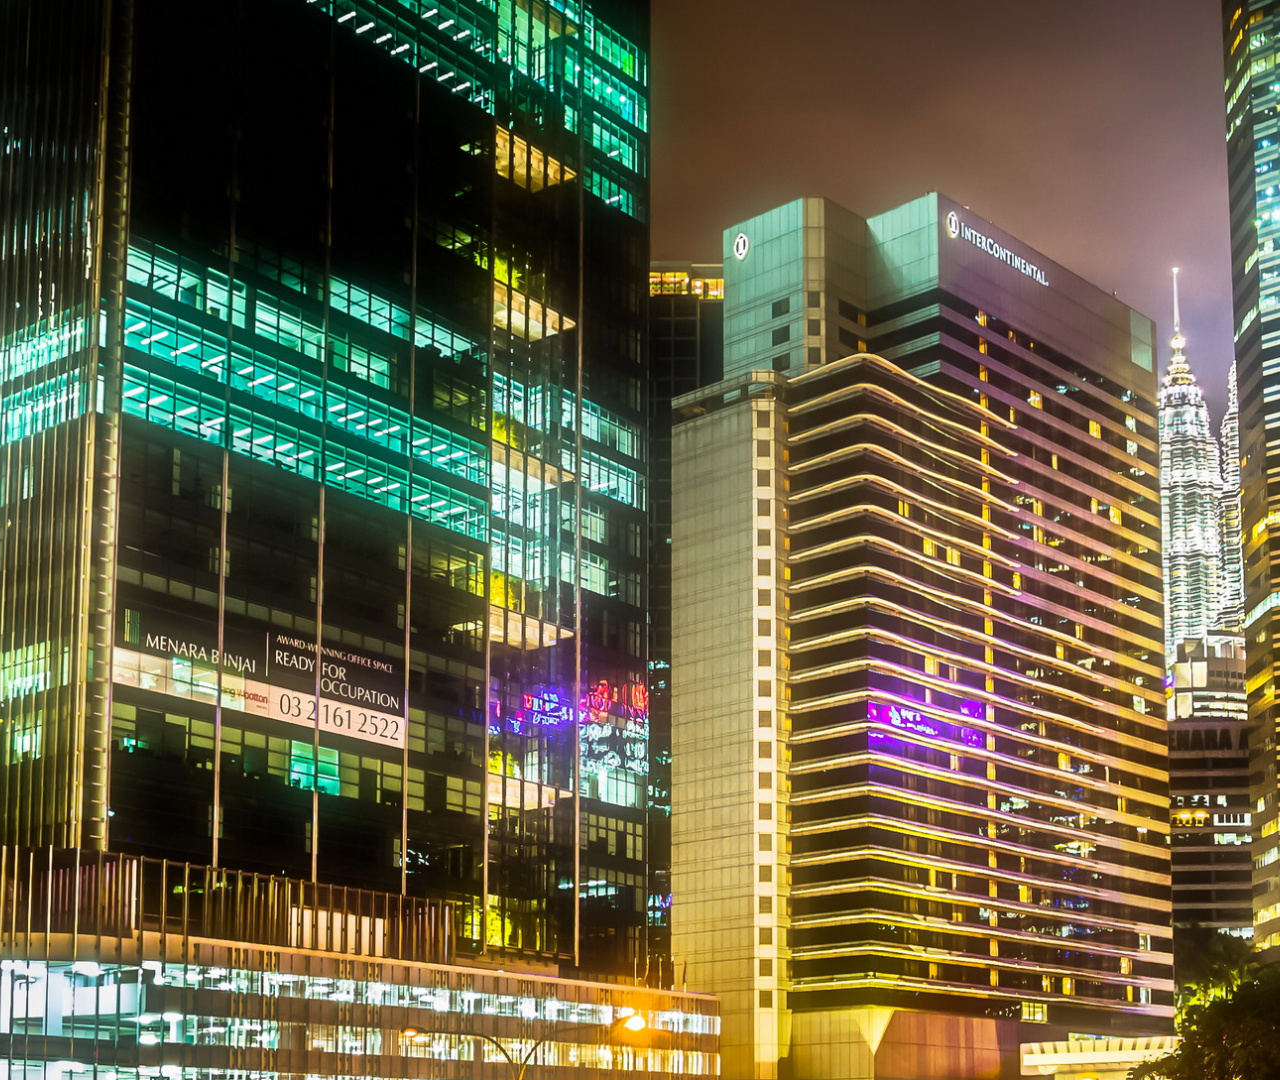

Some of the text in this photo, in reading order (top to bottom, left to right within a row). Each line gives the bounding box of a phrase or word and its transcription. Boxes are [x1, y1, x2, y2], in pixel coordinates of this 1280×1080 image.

[145, 632, 256, 674] MENARA BINJAI
[275, 650, 347, 681] READY FOR
[276, 634, 393, 674] AWARD-WINNING OFFICE SPACE
[321, 678, 400, 710] OCCUPATION
[279, 693, 302, 718] 03
[357, 712, 400, 741] 2522
